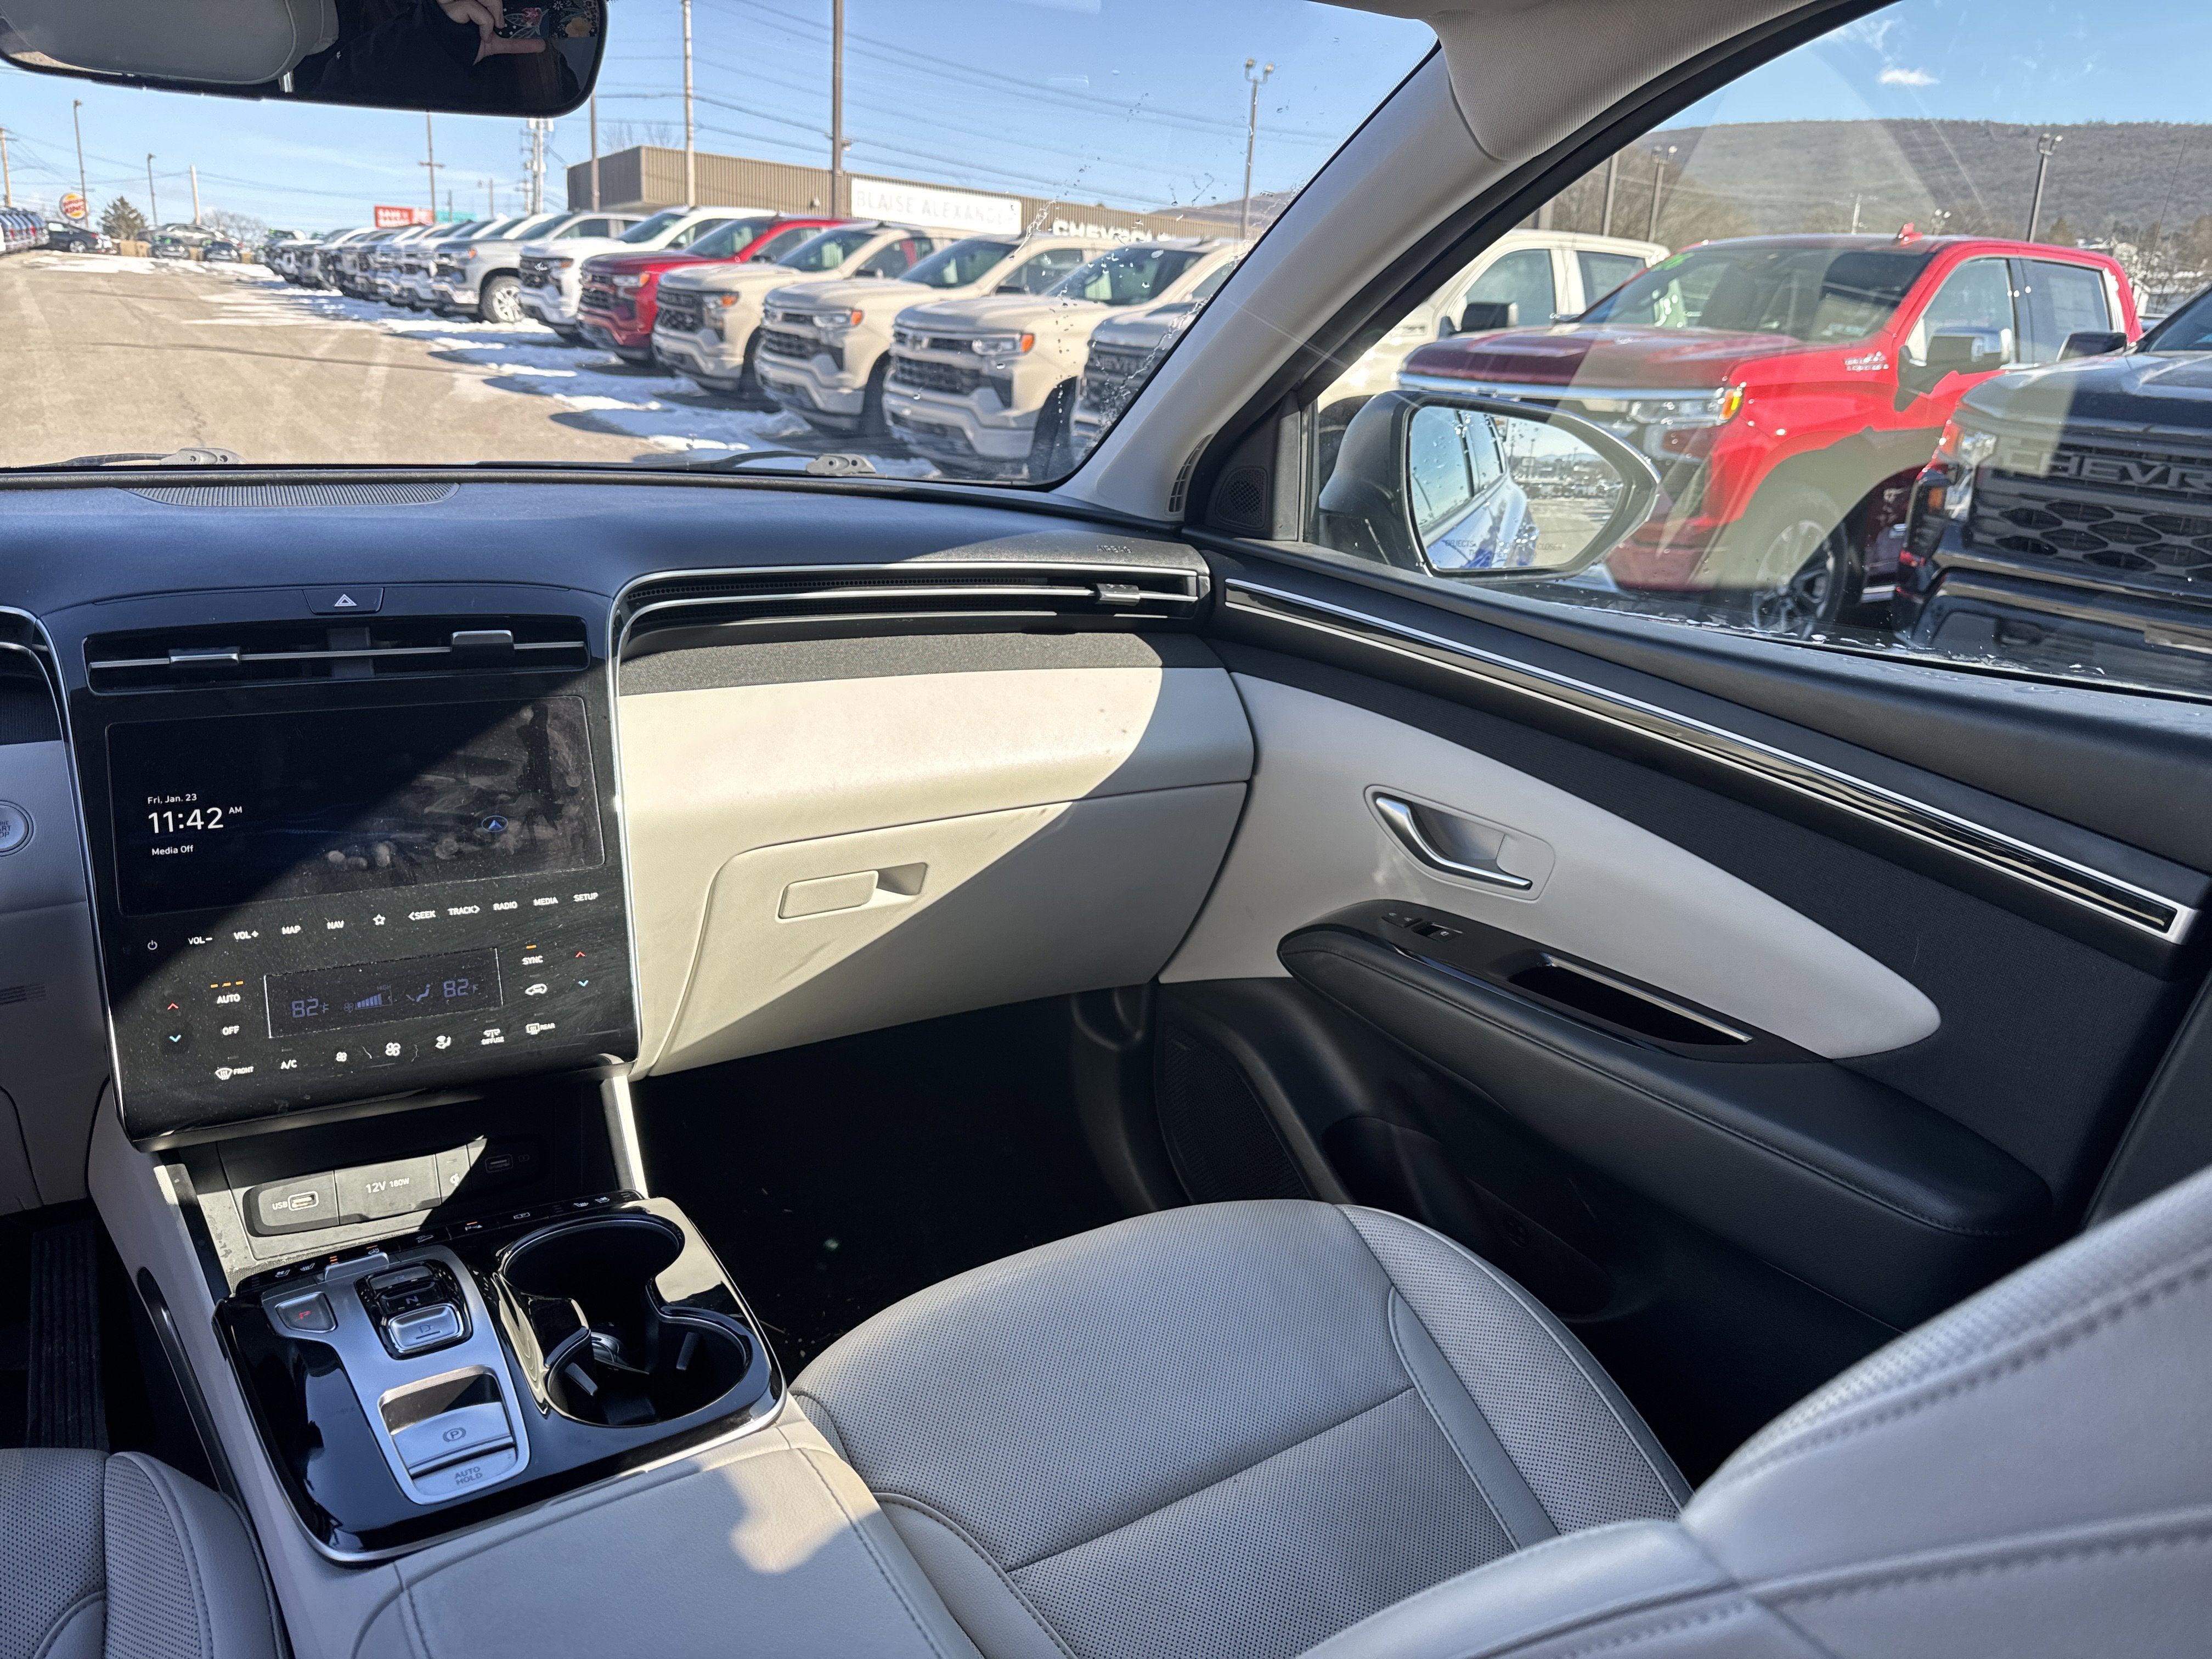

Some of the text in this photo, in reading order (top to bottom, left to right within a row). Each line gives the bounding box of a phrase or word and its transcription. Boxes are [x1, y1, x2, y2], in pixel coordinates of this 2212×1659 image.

[856, 190, 913, 213] BLAISE
[1096, 544, 1132, 554] AIRBAG
[148, 793, 198, 804] Fri, Jan. 23
[148, 806, 243, 834] 11:42 AM
[151, 844, 194, 856] Media Off
[533, 896, 558, 906] MEDIA
[573, 891, 599, 902] SETUP
[493, 900, 518, 911] RADIO
[281, 924, 302, 935] MAP
[326, 919, 345, 930] NAV
[521, 955, 544, 966] SYNC
[216, 993, 241, 1005] AUTO
[222, 1024, 240, 1036] OFF
[539, 1022, 556, 1031] REAR
[481, 1036, 505, 1045] DIFFUSE
[280, 1059, 298, 1070] A/C
[233, 1066, 254, 1076] FRONT
[365, 1177, 410, 1193] 12V 180W
[272, 1200, 288, 1210] USB
[405, 1295, 419, 1305] N
[454, 1466, 481, 1480] AUTO
[455, 1472, 483, 1485] HOLD
